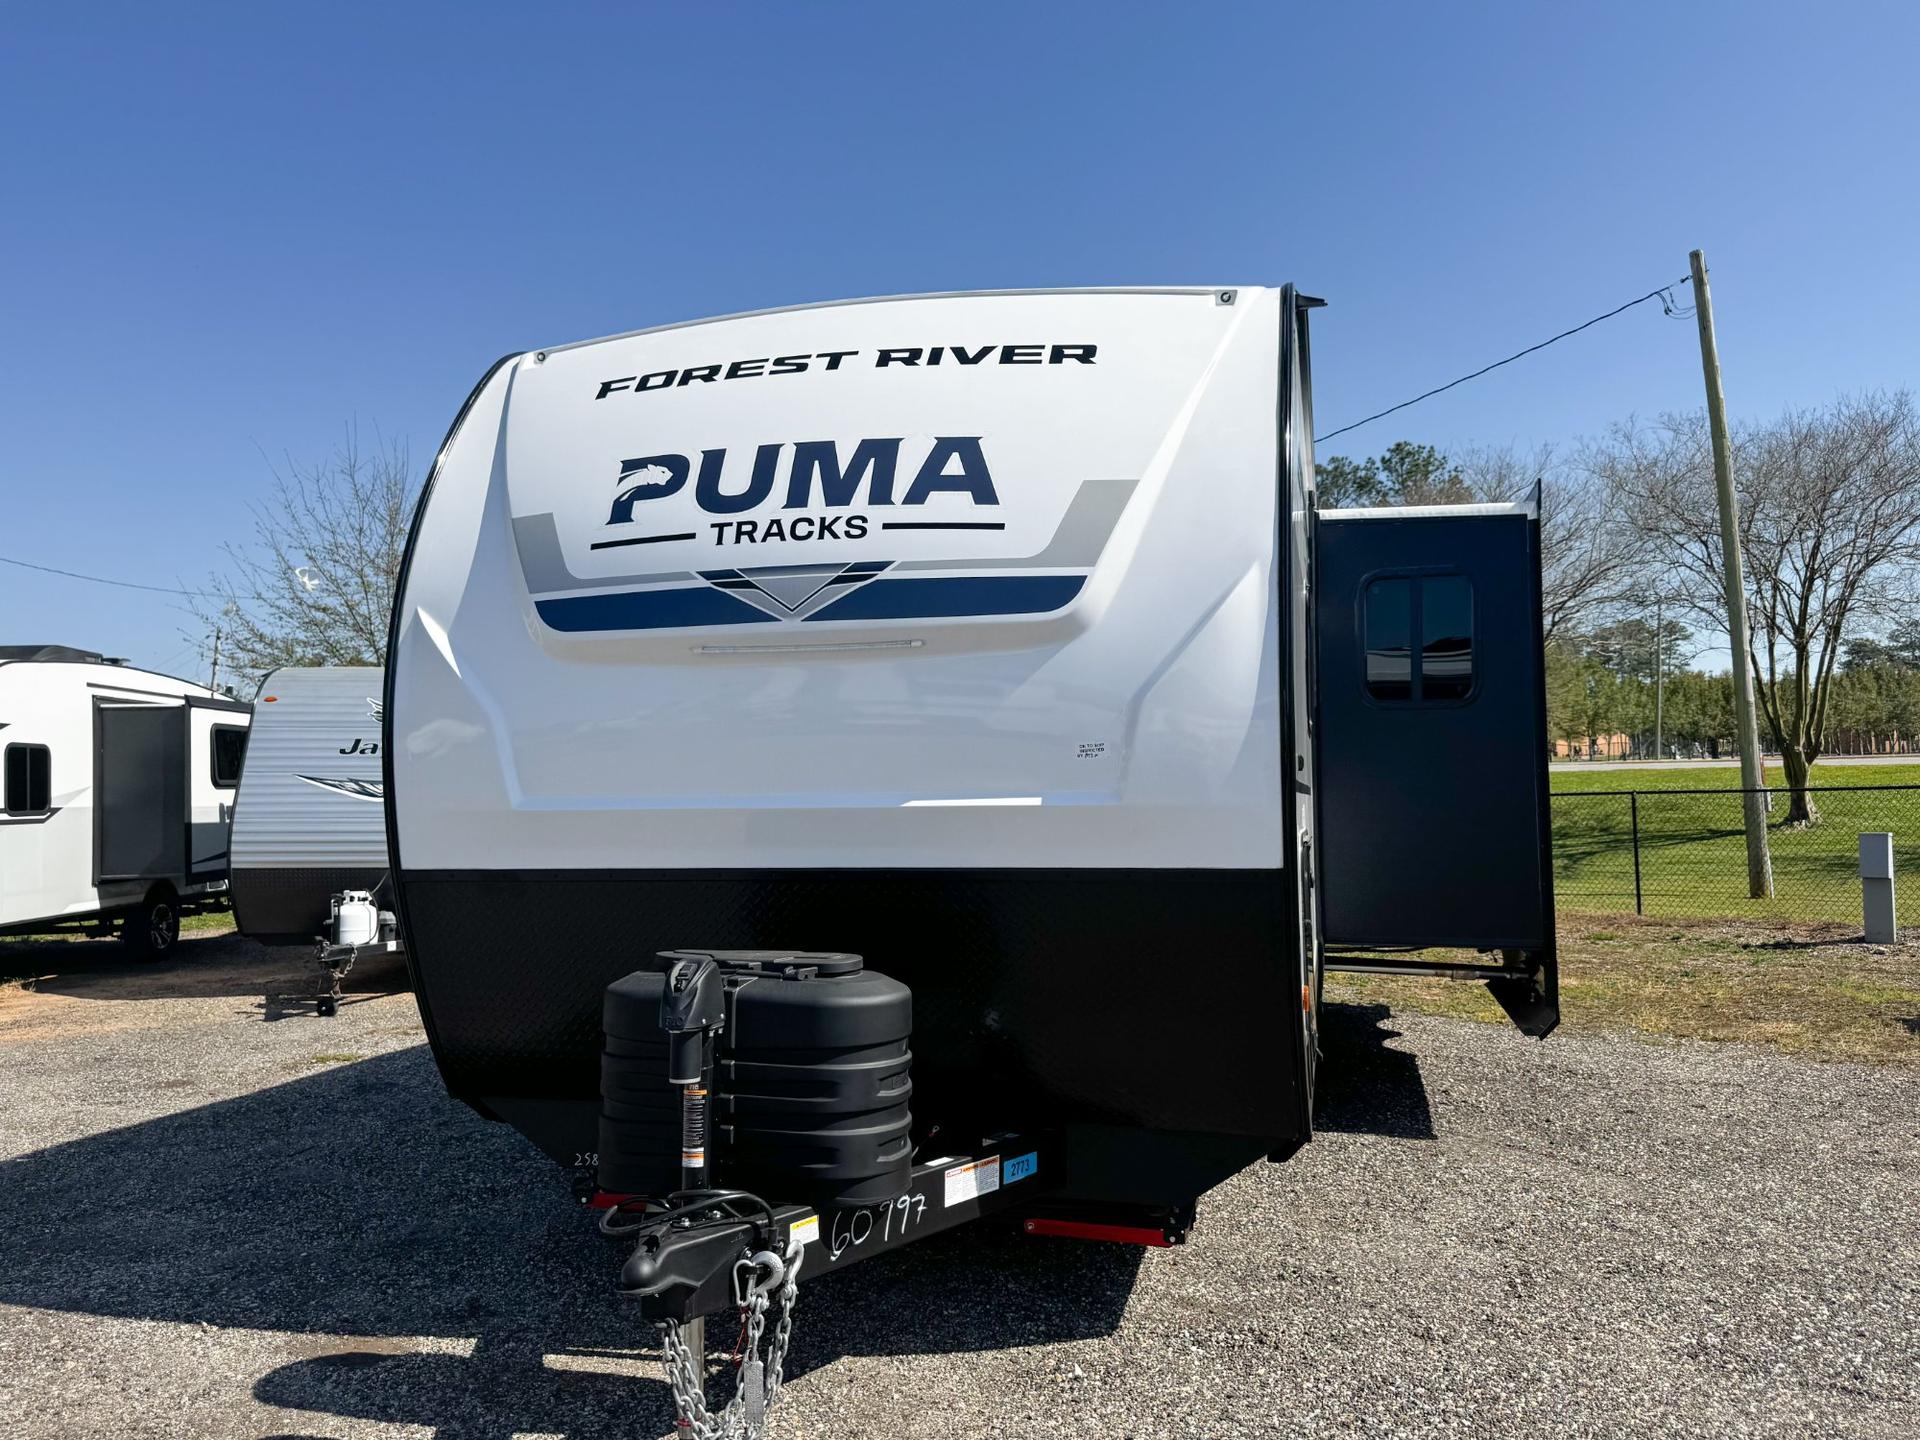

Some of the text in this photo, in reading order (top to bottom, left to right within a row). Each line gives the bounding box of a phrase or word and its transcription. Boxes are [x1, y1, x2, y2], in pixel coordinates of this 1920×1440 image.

[595, 344, 1098, 400] FOREST RIVER
[605, 436, 1000, 525] PUMA
[710, 515, 869, 546] TRACKS
[574, 1152, 599, 1166] 258
[1011, 1158, 1030, 1177] 2773
